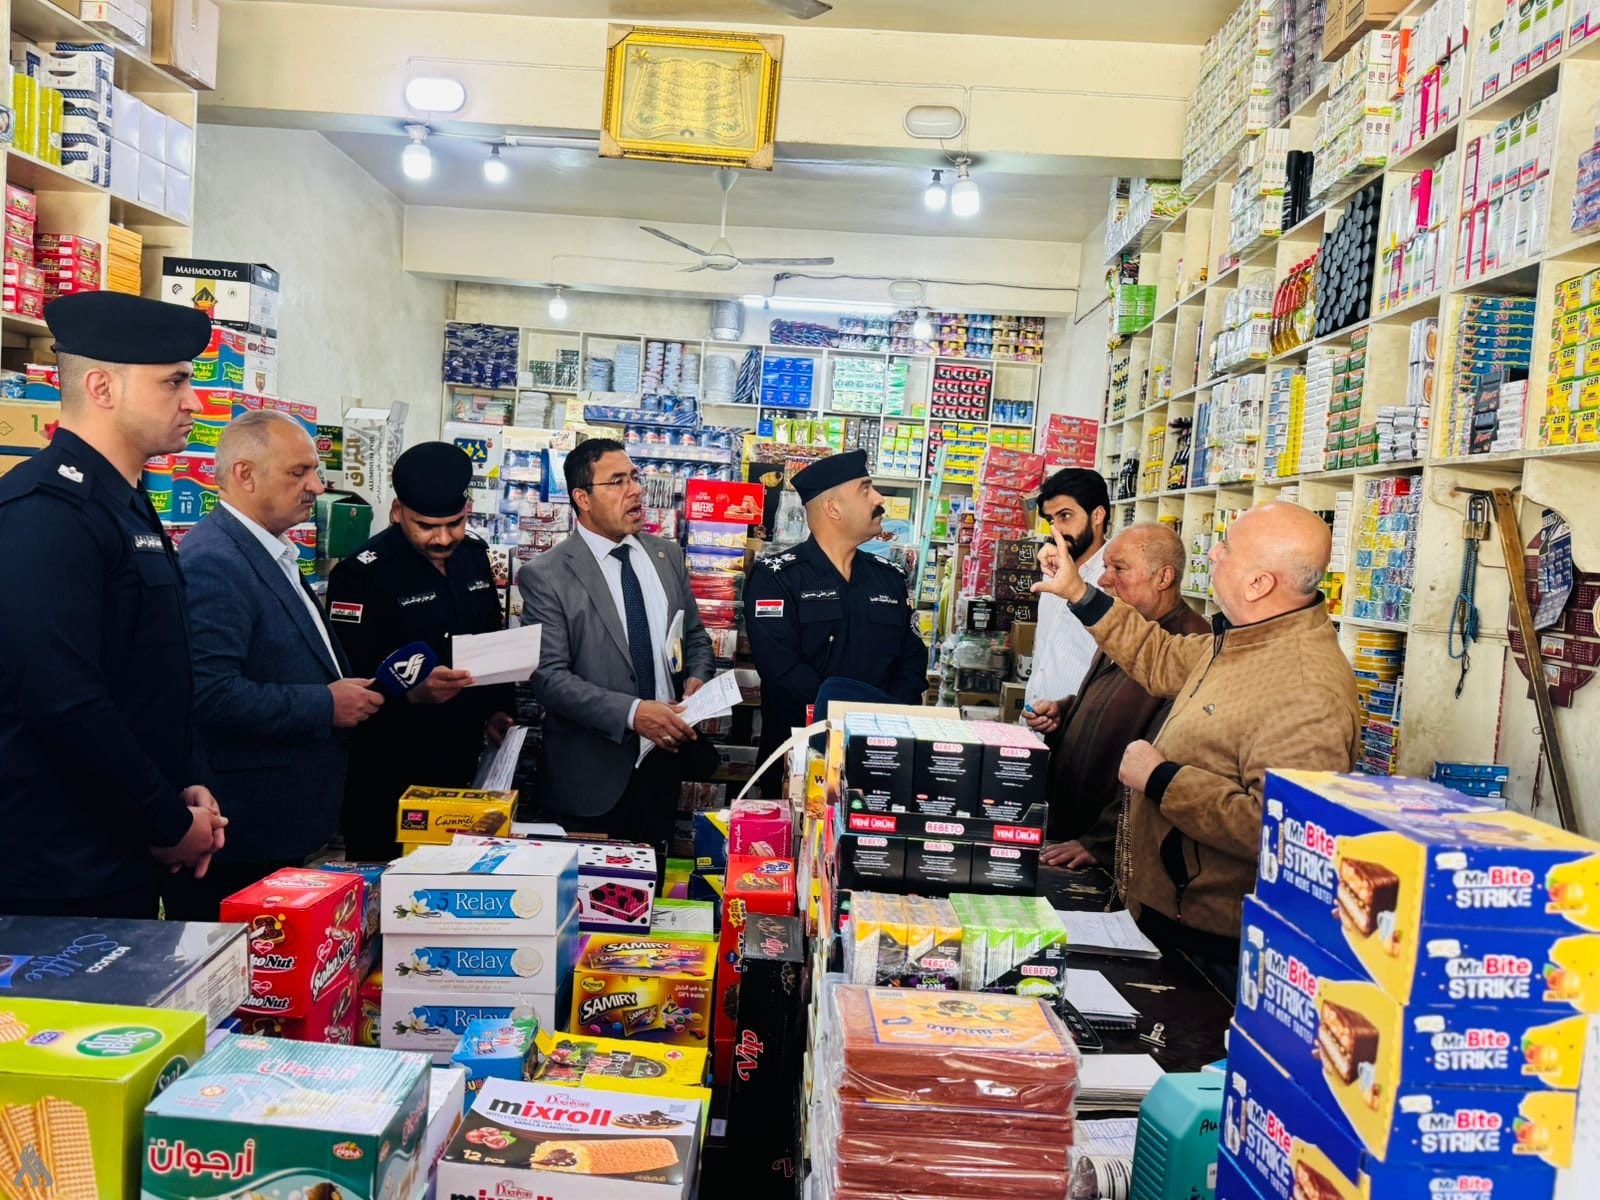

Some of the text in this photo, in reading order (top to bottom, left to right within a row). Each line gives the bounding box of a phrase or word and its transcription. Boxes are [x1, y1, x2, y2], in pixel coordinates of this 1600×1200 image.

[175, 265, 238, 278] MAHMOOD TEA
[1563, 348, 1575, 358] ZER
[1561, 382, 1573, 391] ZER
[1586, 377, 1599, 386] ZER
[1553, 415, 1566, 424] ZER
[1582, 412, 1595, 421] ZER
[691, 501, 714, 513] WAFERS
[868, 738, 896, 746] BEBETO
[934, 744, 962, 752] BEBETO
[1001, 749, 1029, 757] BEBETO
[435, 815, 474, 827] Caramel
[851, 815, 895, 830] YENİ ÜRÜN
[927, 823, 963, 834] BEBETO
[995, 827, 1039, 841] YENİ ÜRÜN
[1306, 823, 1334, 857] Bite
[858, 838, 886, 846] BEBETO
[925, 843, 953, 851] BEBETO
[991, 849, 1019, 858] BEBETO
[1284, 843, 1334, 889] STRIKE
[1491, 868, 1532, 885] Bite
[455, 891, 508, 916] Relay
[1456, 888, 1533, 909] STRIKE
[605, 942, 671, 952] SAMIRY
[456, 950, 508, 975] Relay
[921, 958, 956, 968] BEBETO
[1485, 956, 1529, 975] Bite
[1022, 966, 1057, 976] BEBETO
[1289, 959, 1316, 997] Bite
[1449, 978, 1531, 999] STRIKE
[583, 993, 637, 1020] SAMIRY
[1265, 973, 1315, 1030] STRIKE
[1467, 1030, 1508, 1048] Bite
[735, 1029, 764, 1082] Vip
[1434, 1049, 1509, 1070] STRIKE
[488, 1098, 612, 1127] mixroll
[1457, 1110, 1501, 1130] Bite
[1267, 1111, 1291, 1154] Bite
[1421, 1131, 1501, 1153] STRIKE
[148, 1138, 256, 1179] أرجوان
[463, 1149, 482, 1161] 12
[1246, 1123, 1290, 1186] STRIKE
[1458, 1176, 1492, 1191] Bite
